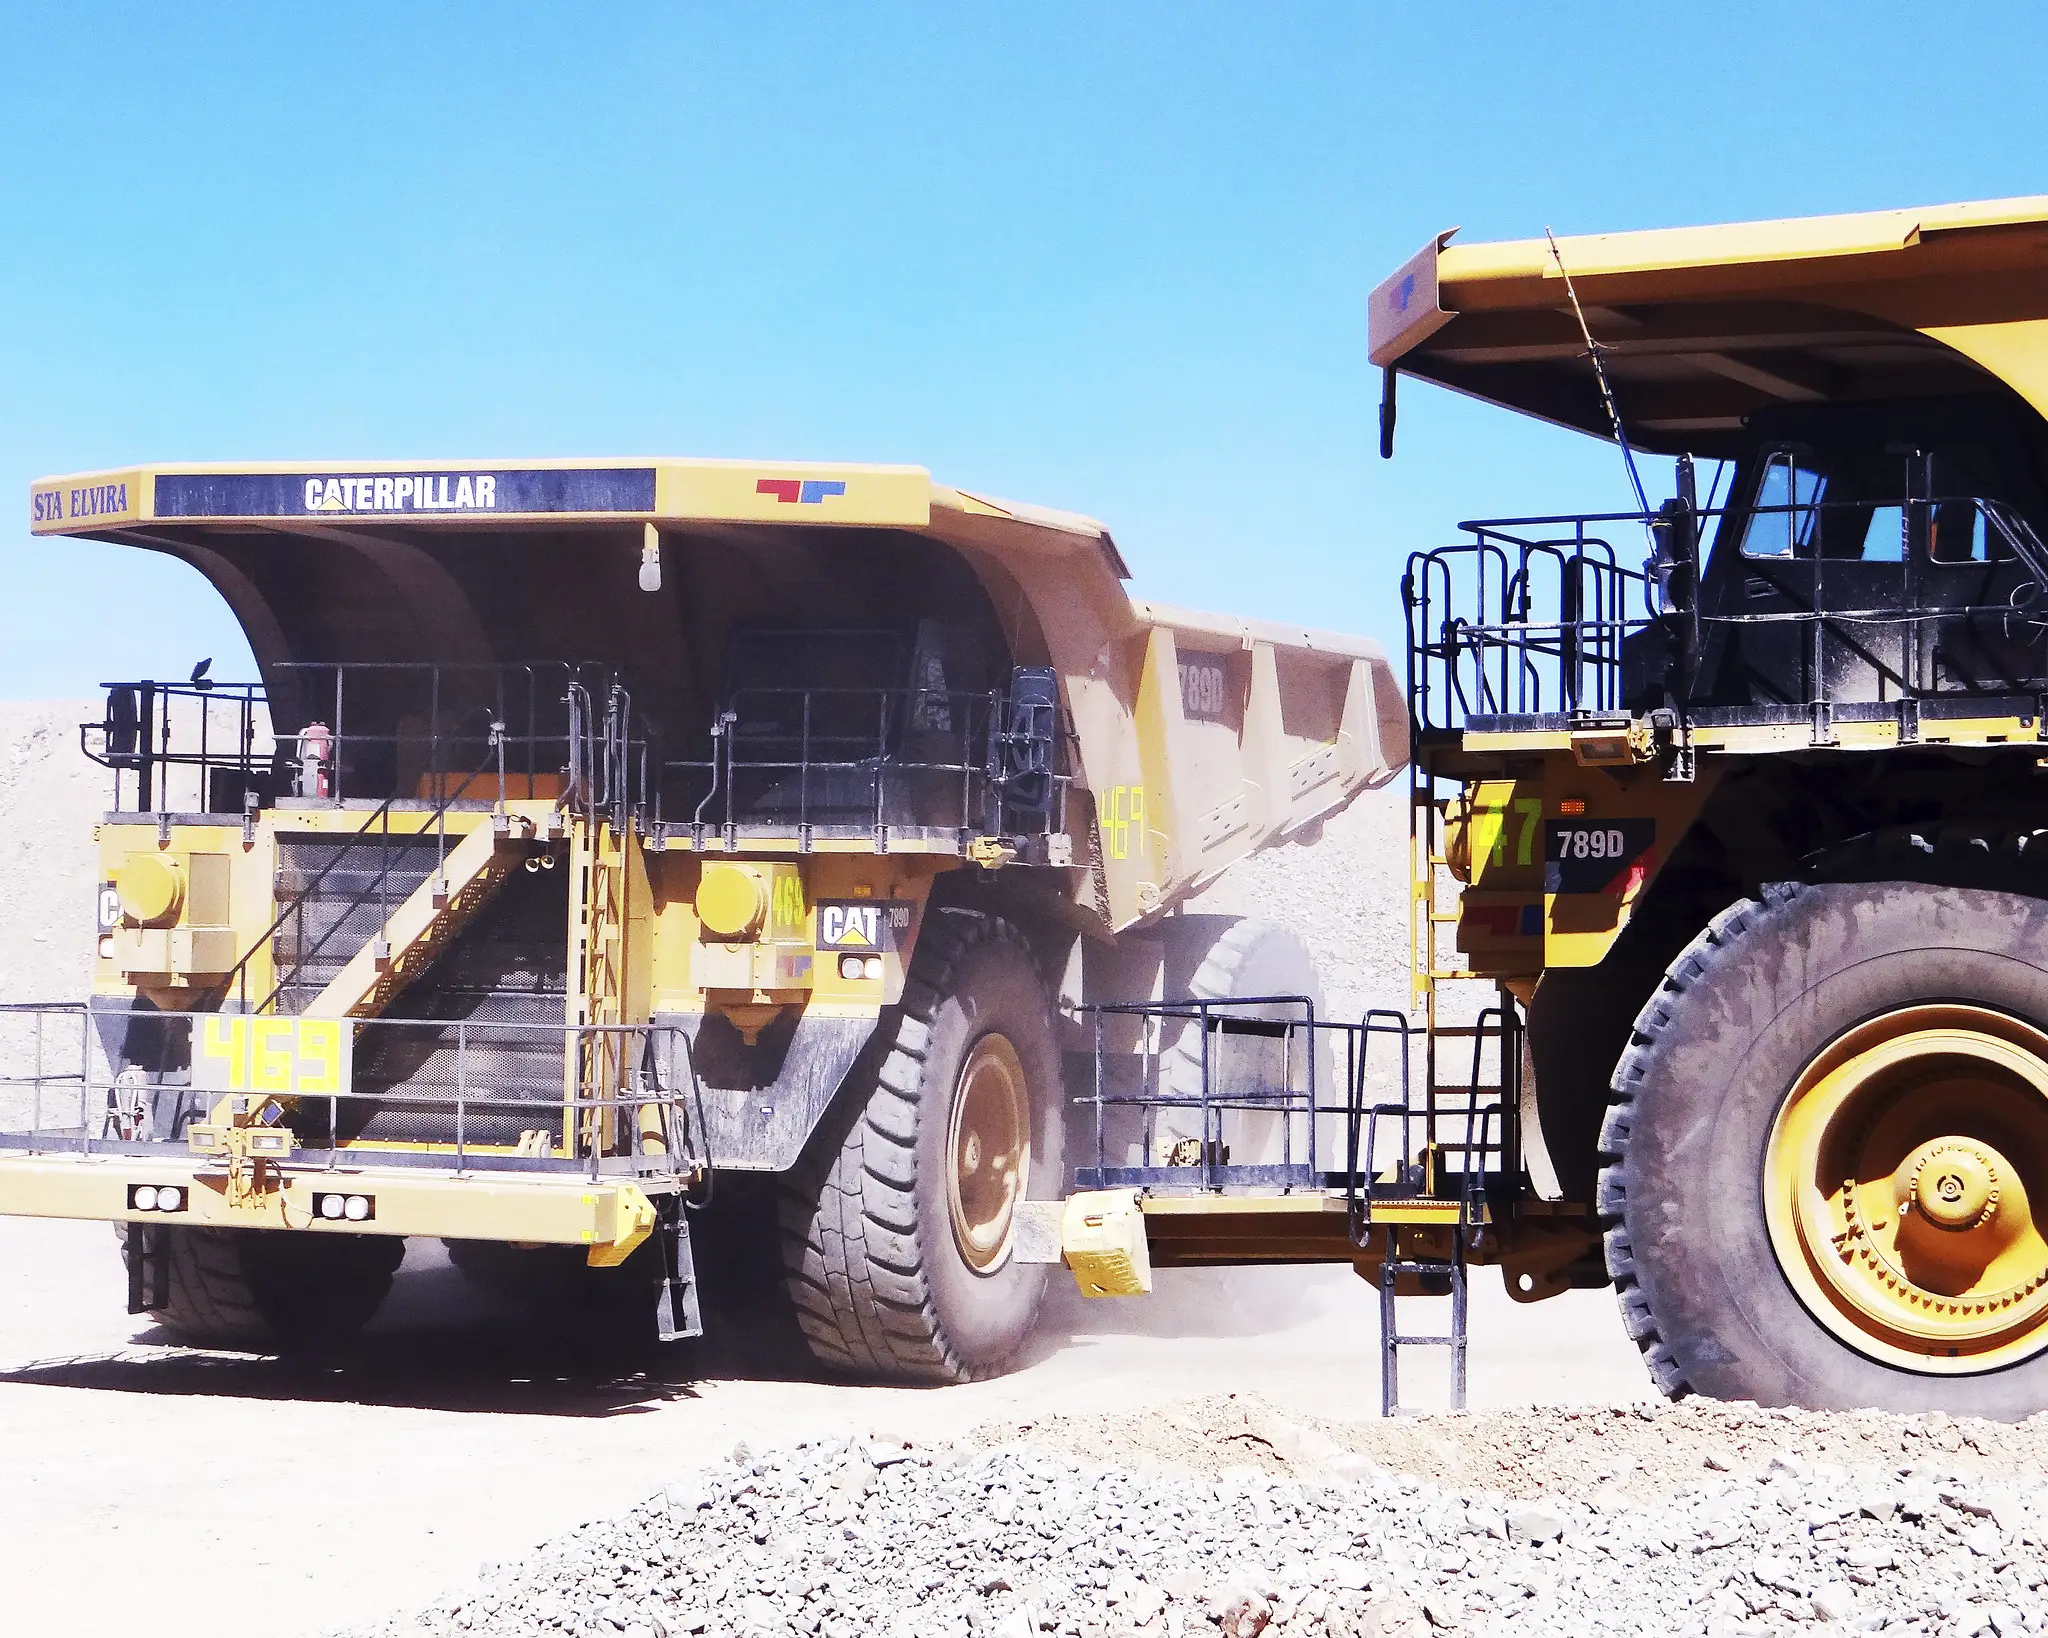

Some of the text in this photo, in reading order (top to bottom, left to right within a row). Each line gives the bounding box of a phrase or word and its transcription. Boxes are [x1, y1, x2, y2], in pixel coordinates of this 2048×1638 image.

[34, 483, 127, 521] STA ELVIRA
[304, 475, 497, 511] CATERPILLAR
[1101, 785, 1144, 860] 469
[1557, 829, 1624, 859] 789D
[823, 905, 882, 946] CAT
[889, 907, 910, 928] 789D
[204, 1016, 341, 1093] 469
